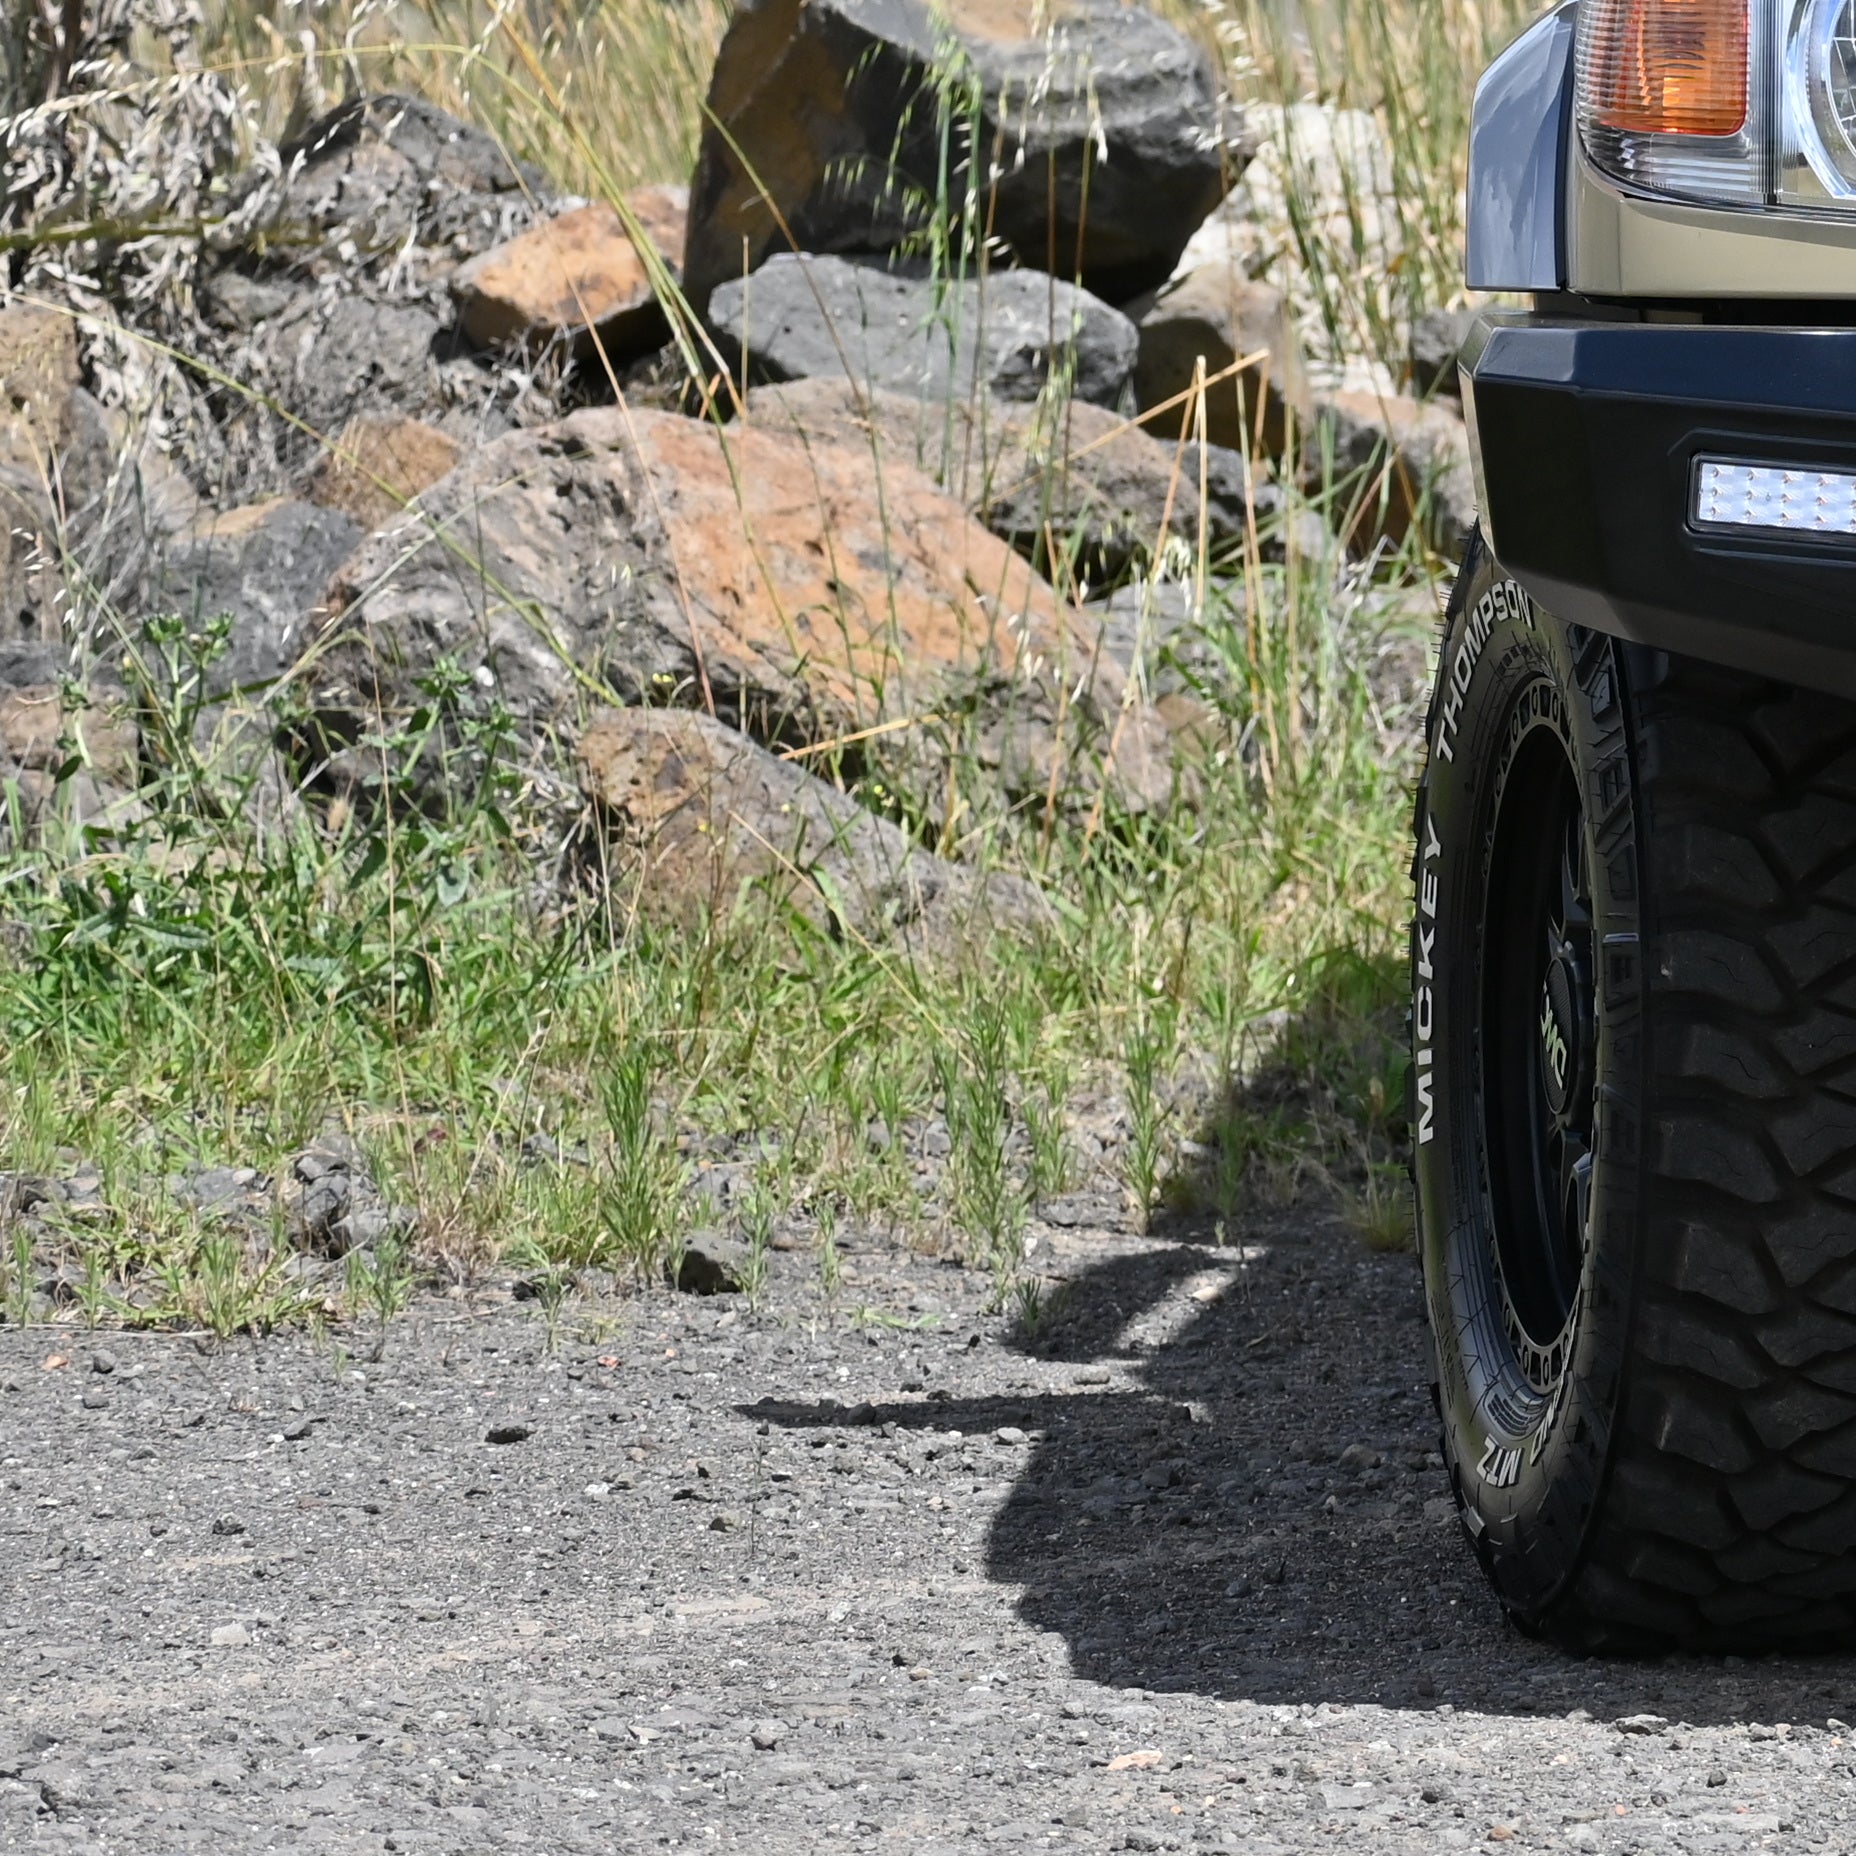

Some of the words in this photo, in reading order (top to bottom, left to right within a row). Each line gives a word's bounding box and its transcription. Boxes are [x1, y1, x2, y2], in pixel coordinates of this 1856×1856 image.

[1417, 812, 1441, 1145] MICKEY
[1436, 579, 1534, 763] THOMPSON
[1475, 1432, 1526, 1488] MTZ
